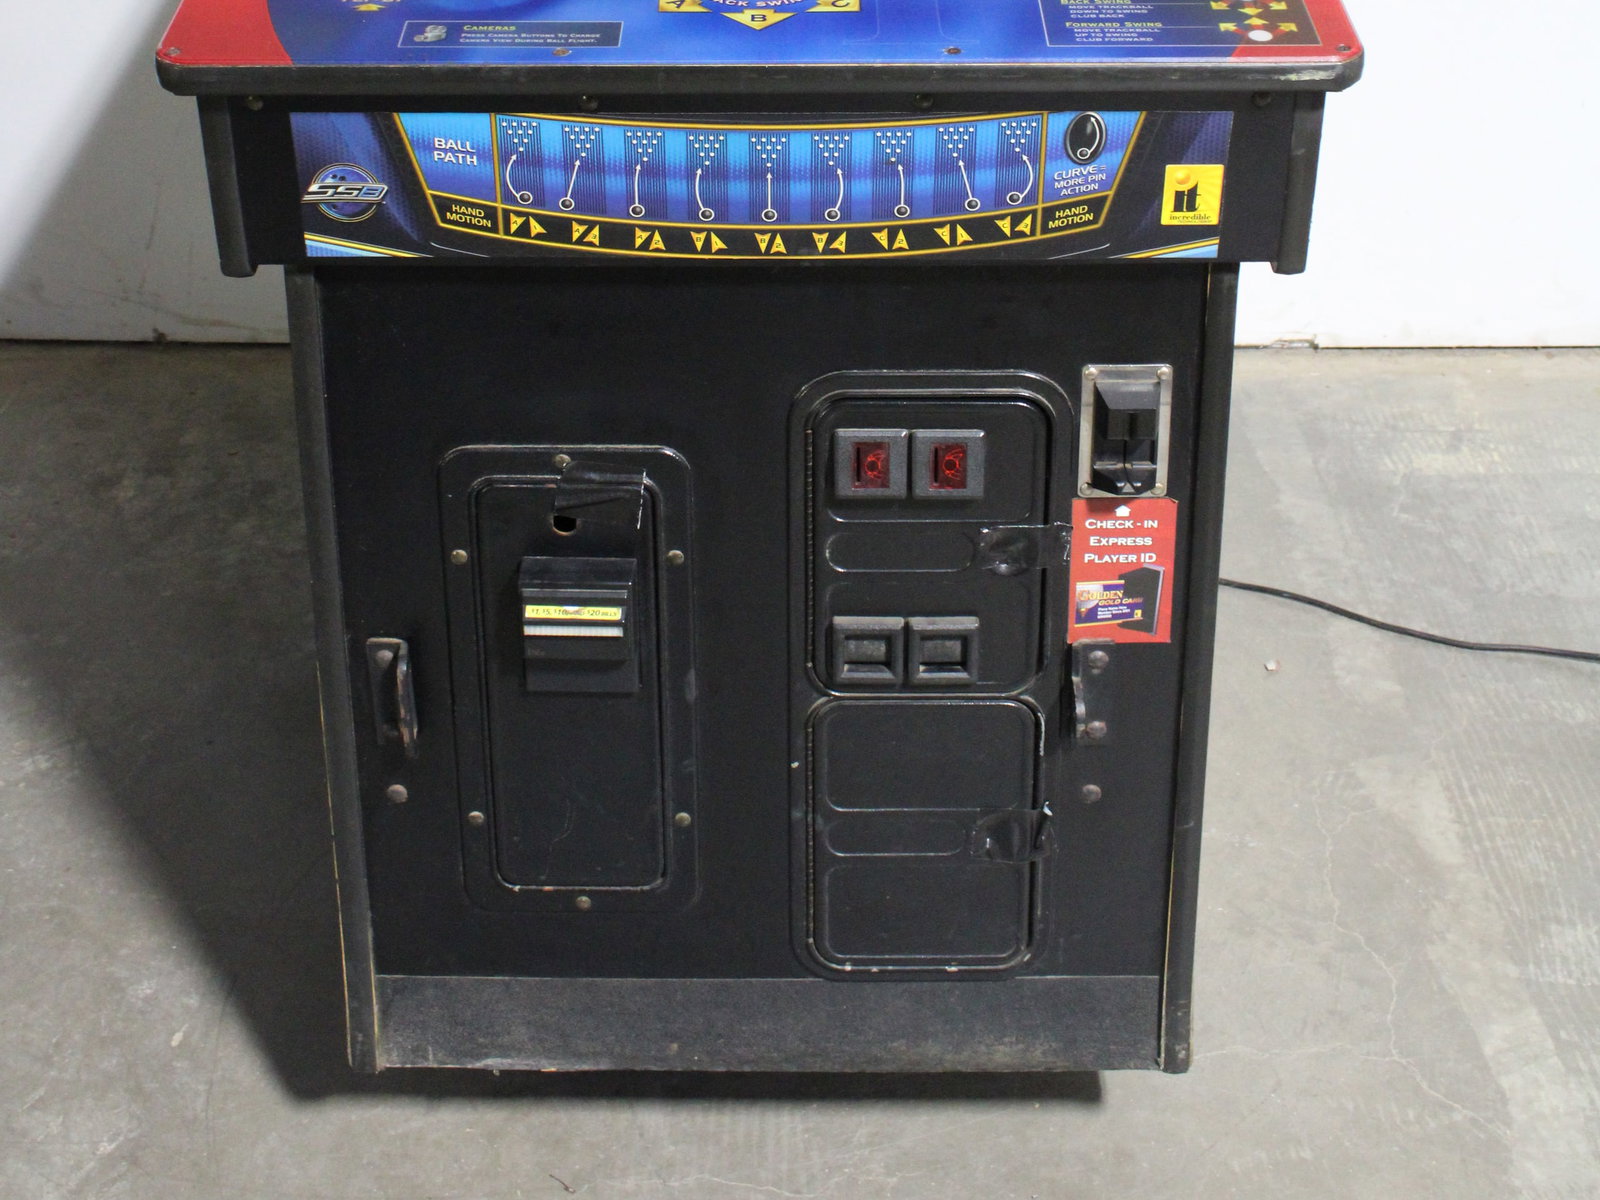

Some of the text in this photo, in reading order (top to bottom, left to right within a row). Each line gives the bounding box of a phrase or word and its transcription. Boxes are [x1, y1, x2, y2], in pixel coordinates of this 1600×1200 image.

[665, 0, 686, 9] A
[831, 0, 850, 8] C
[750, 14, 767, 22] B
[433, 137, 477, 154] BALL
[433, 151, 478, 167] PATH
[1054, 165, 1098, 181] CURVE
[1054, 173, 1107, 190] MORE PIN
[1060, 183, 1100, 197] ACTION
[452, 204, 485, 218] HAND
[1055, 205, 1089, 218] HAND
[1169, 213, 1212, 221] incredible
[446, 212, 493, 228] MOTION
[1048, 213, 1094, 229] MOTION
[1090, 536, 1153, 546] EXPRESS
[1084, 552, 1157, 563] PLAYER ID
[1078, 590, 1124, 601] GOLDEN
